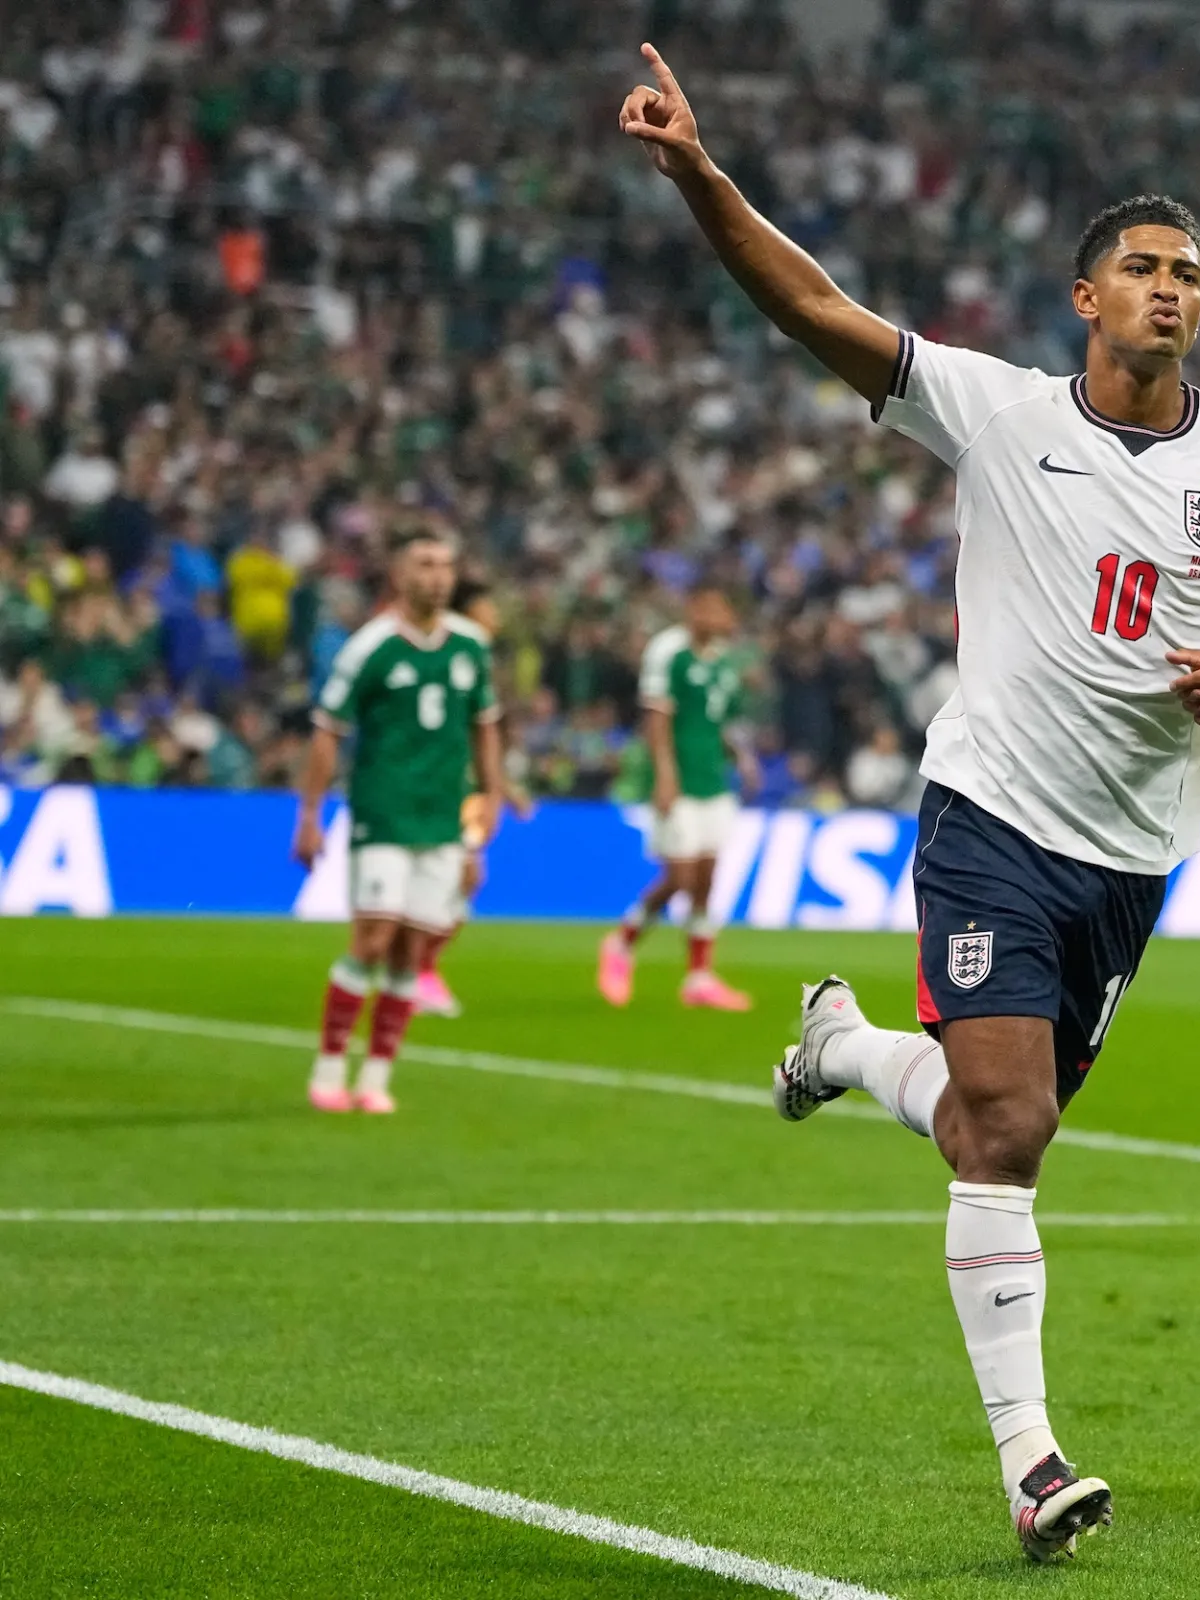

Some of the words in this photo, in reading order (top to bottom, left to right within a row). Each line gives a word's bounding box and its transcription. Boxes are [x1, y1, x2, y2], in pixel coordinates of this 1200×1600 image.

[1091, 552, 1159, 641] 10
[416, 683, 447, 730] 6
[0, 784, 115, 917] A
[1090, 971, 1133, 1046] 1
